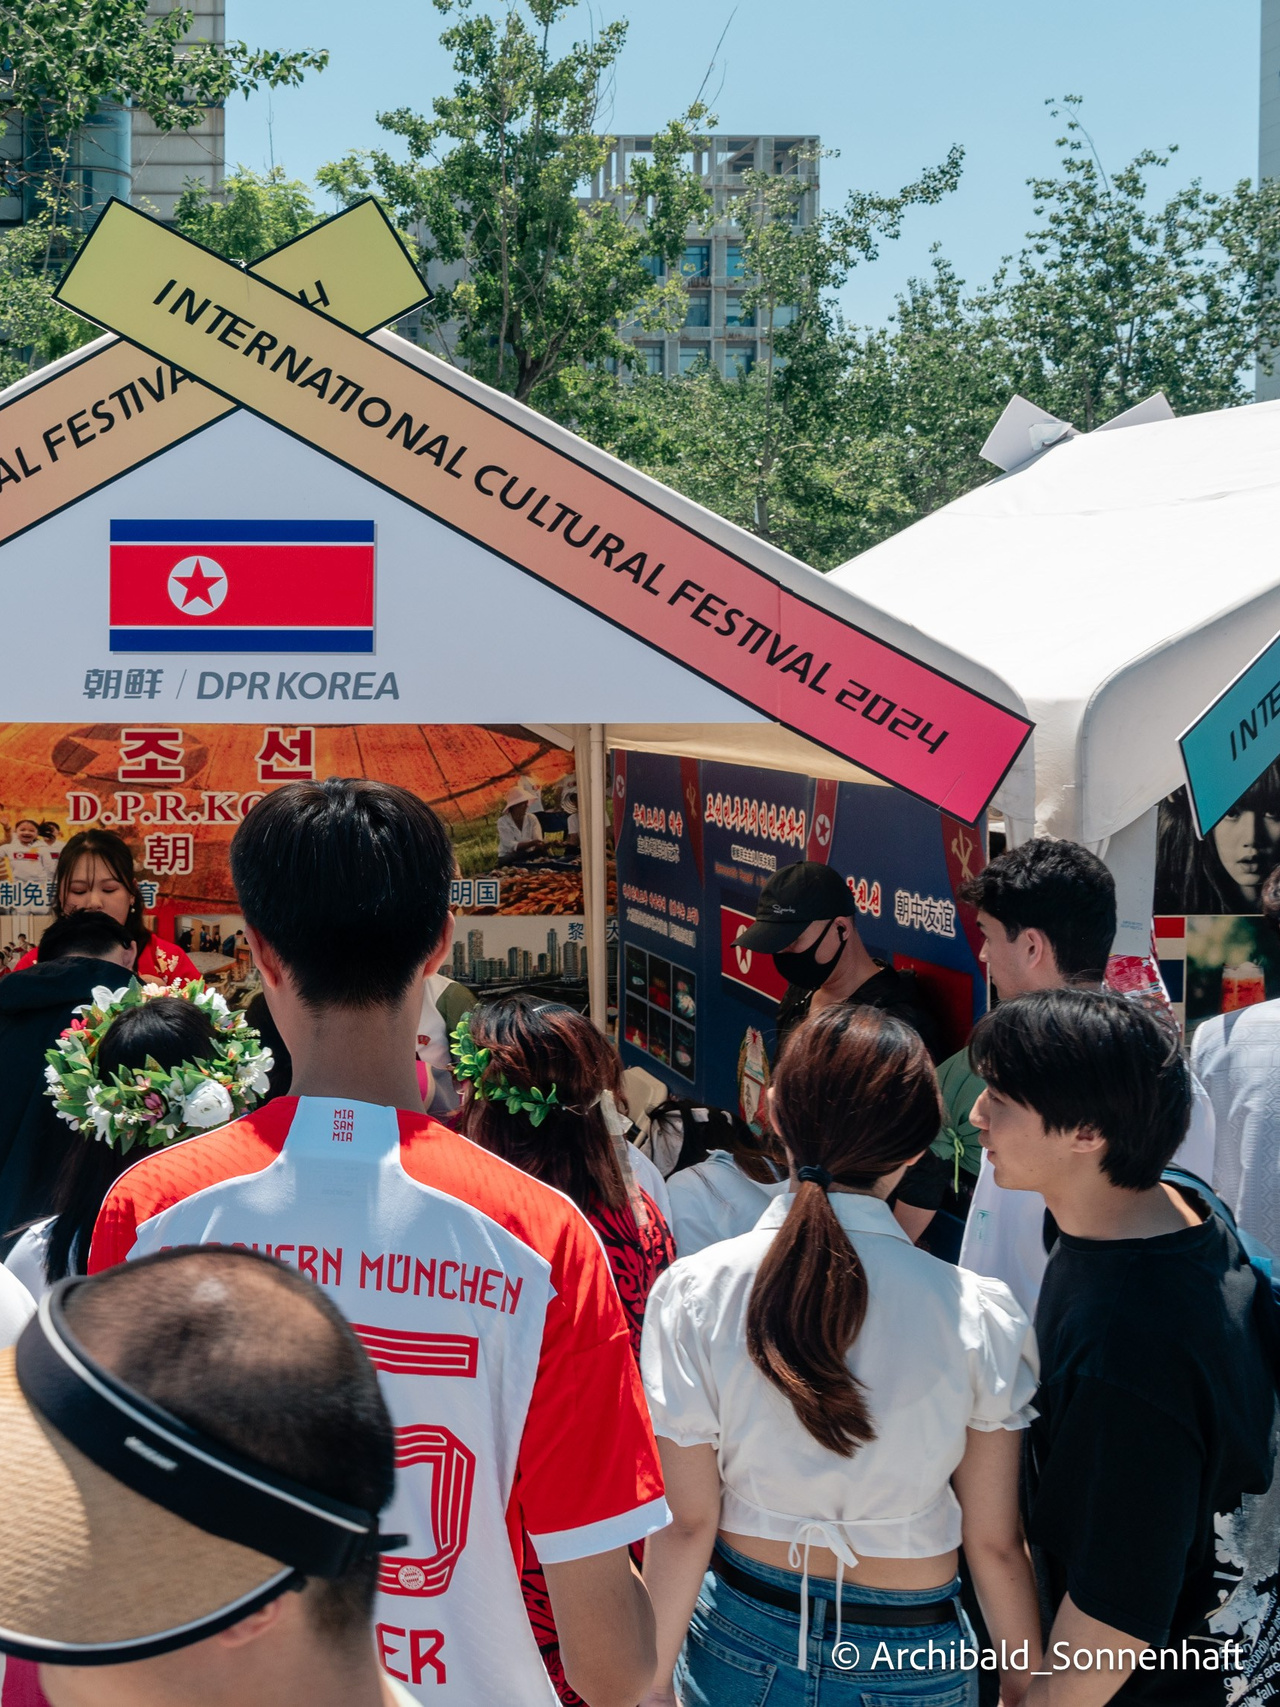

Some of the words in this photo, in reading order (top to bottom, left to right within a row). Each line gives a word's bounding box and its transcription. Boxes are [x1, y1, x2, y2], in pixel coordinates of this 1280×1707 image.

[42, 365, 196, 463] FESTIVA
[152, 279, 470, 482] INTERNATIONAL
[474, 465, 666, 597] CULTURAL
[668, 578, 831, 696] FESTIVAL
[834, 680, 950, 756] 2024
[82, 668, 164, 700] 朝鲜
[276, 671, 400, 700] KOREA
[895, 891, 956, 937] 朝中友谊
[333, 1120, 354, 1131] SAN
[334, 1109, 354, 1119] MIA
[332, 1132, 353, 1142] MIA
[360, 1250, 524, 1315] MÜNCHEN
[375, 1622, 447, 1685] ER
